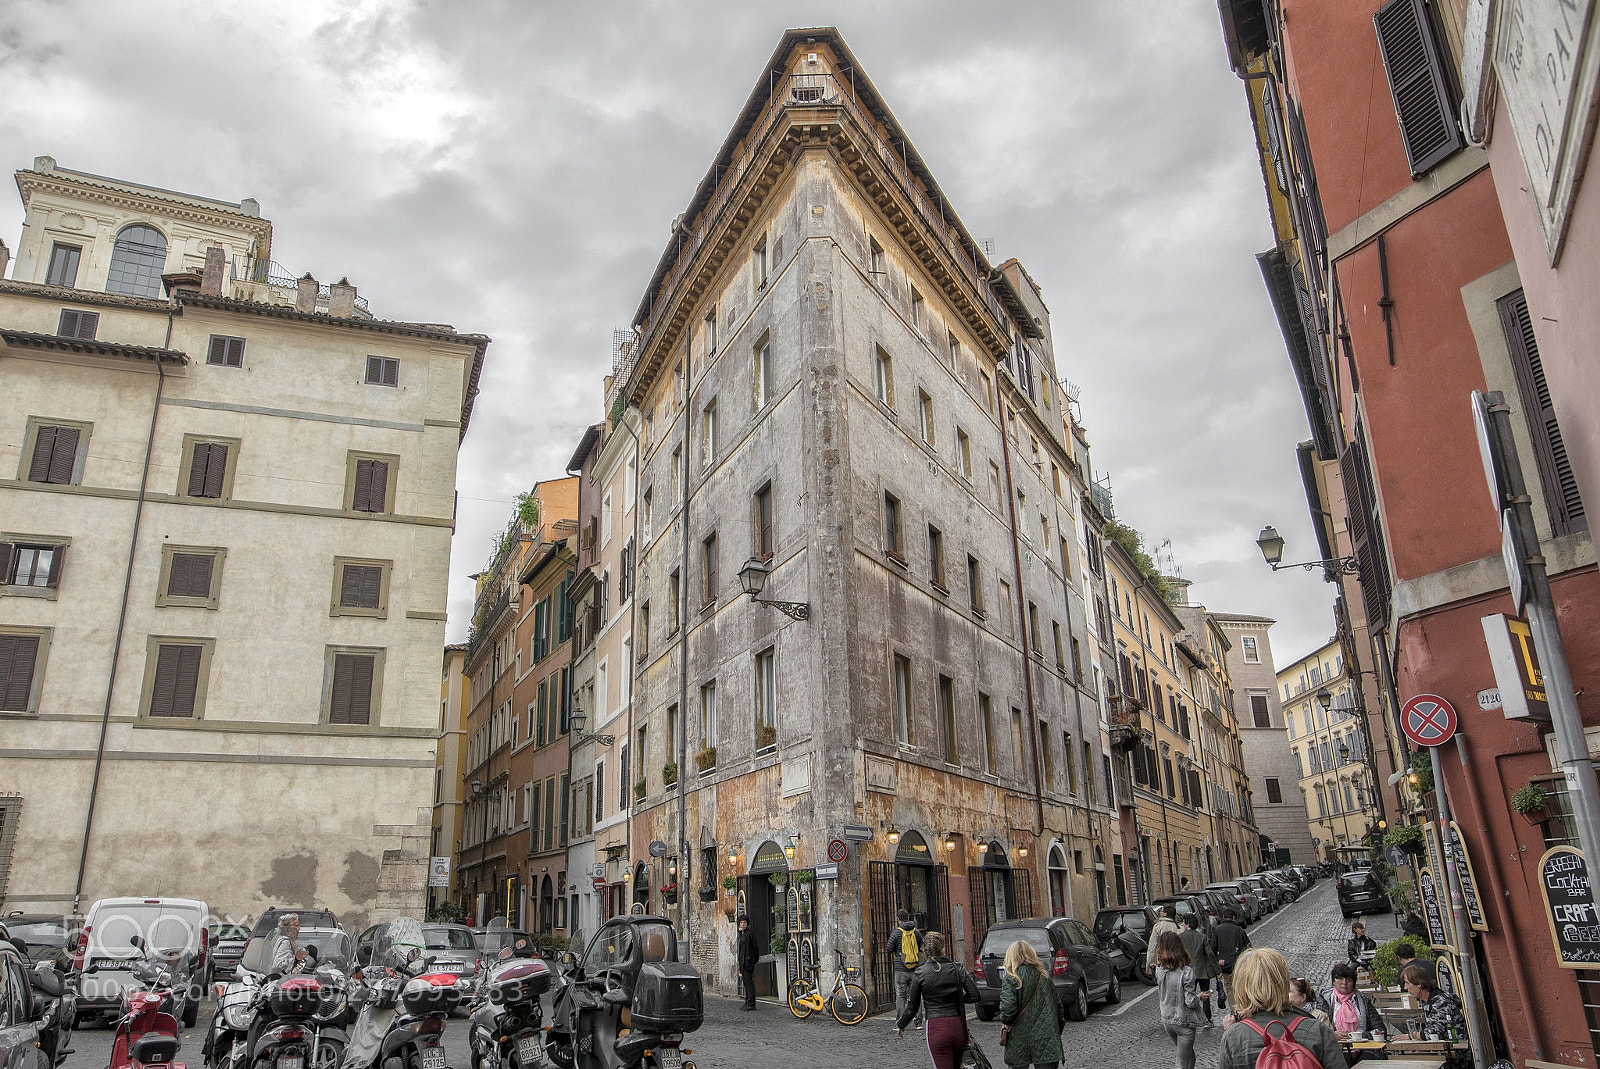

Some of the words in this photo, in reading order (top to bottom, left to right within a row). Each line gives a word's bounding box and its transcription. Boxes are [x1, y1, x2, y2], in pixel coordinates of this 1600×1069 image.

[1535, 100, 1555, 179] DI
[1507, 619, 1537, 686] T
[1546, 872, 1591, 889] COCKTAI
[1566, 888, 1587, 897] BAR
